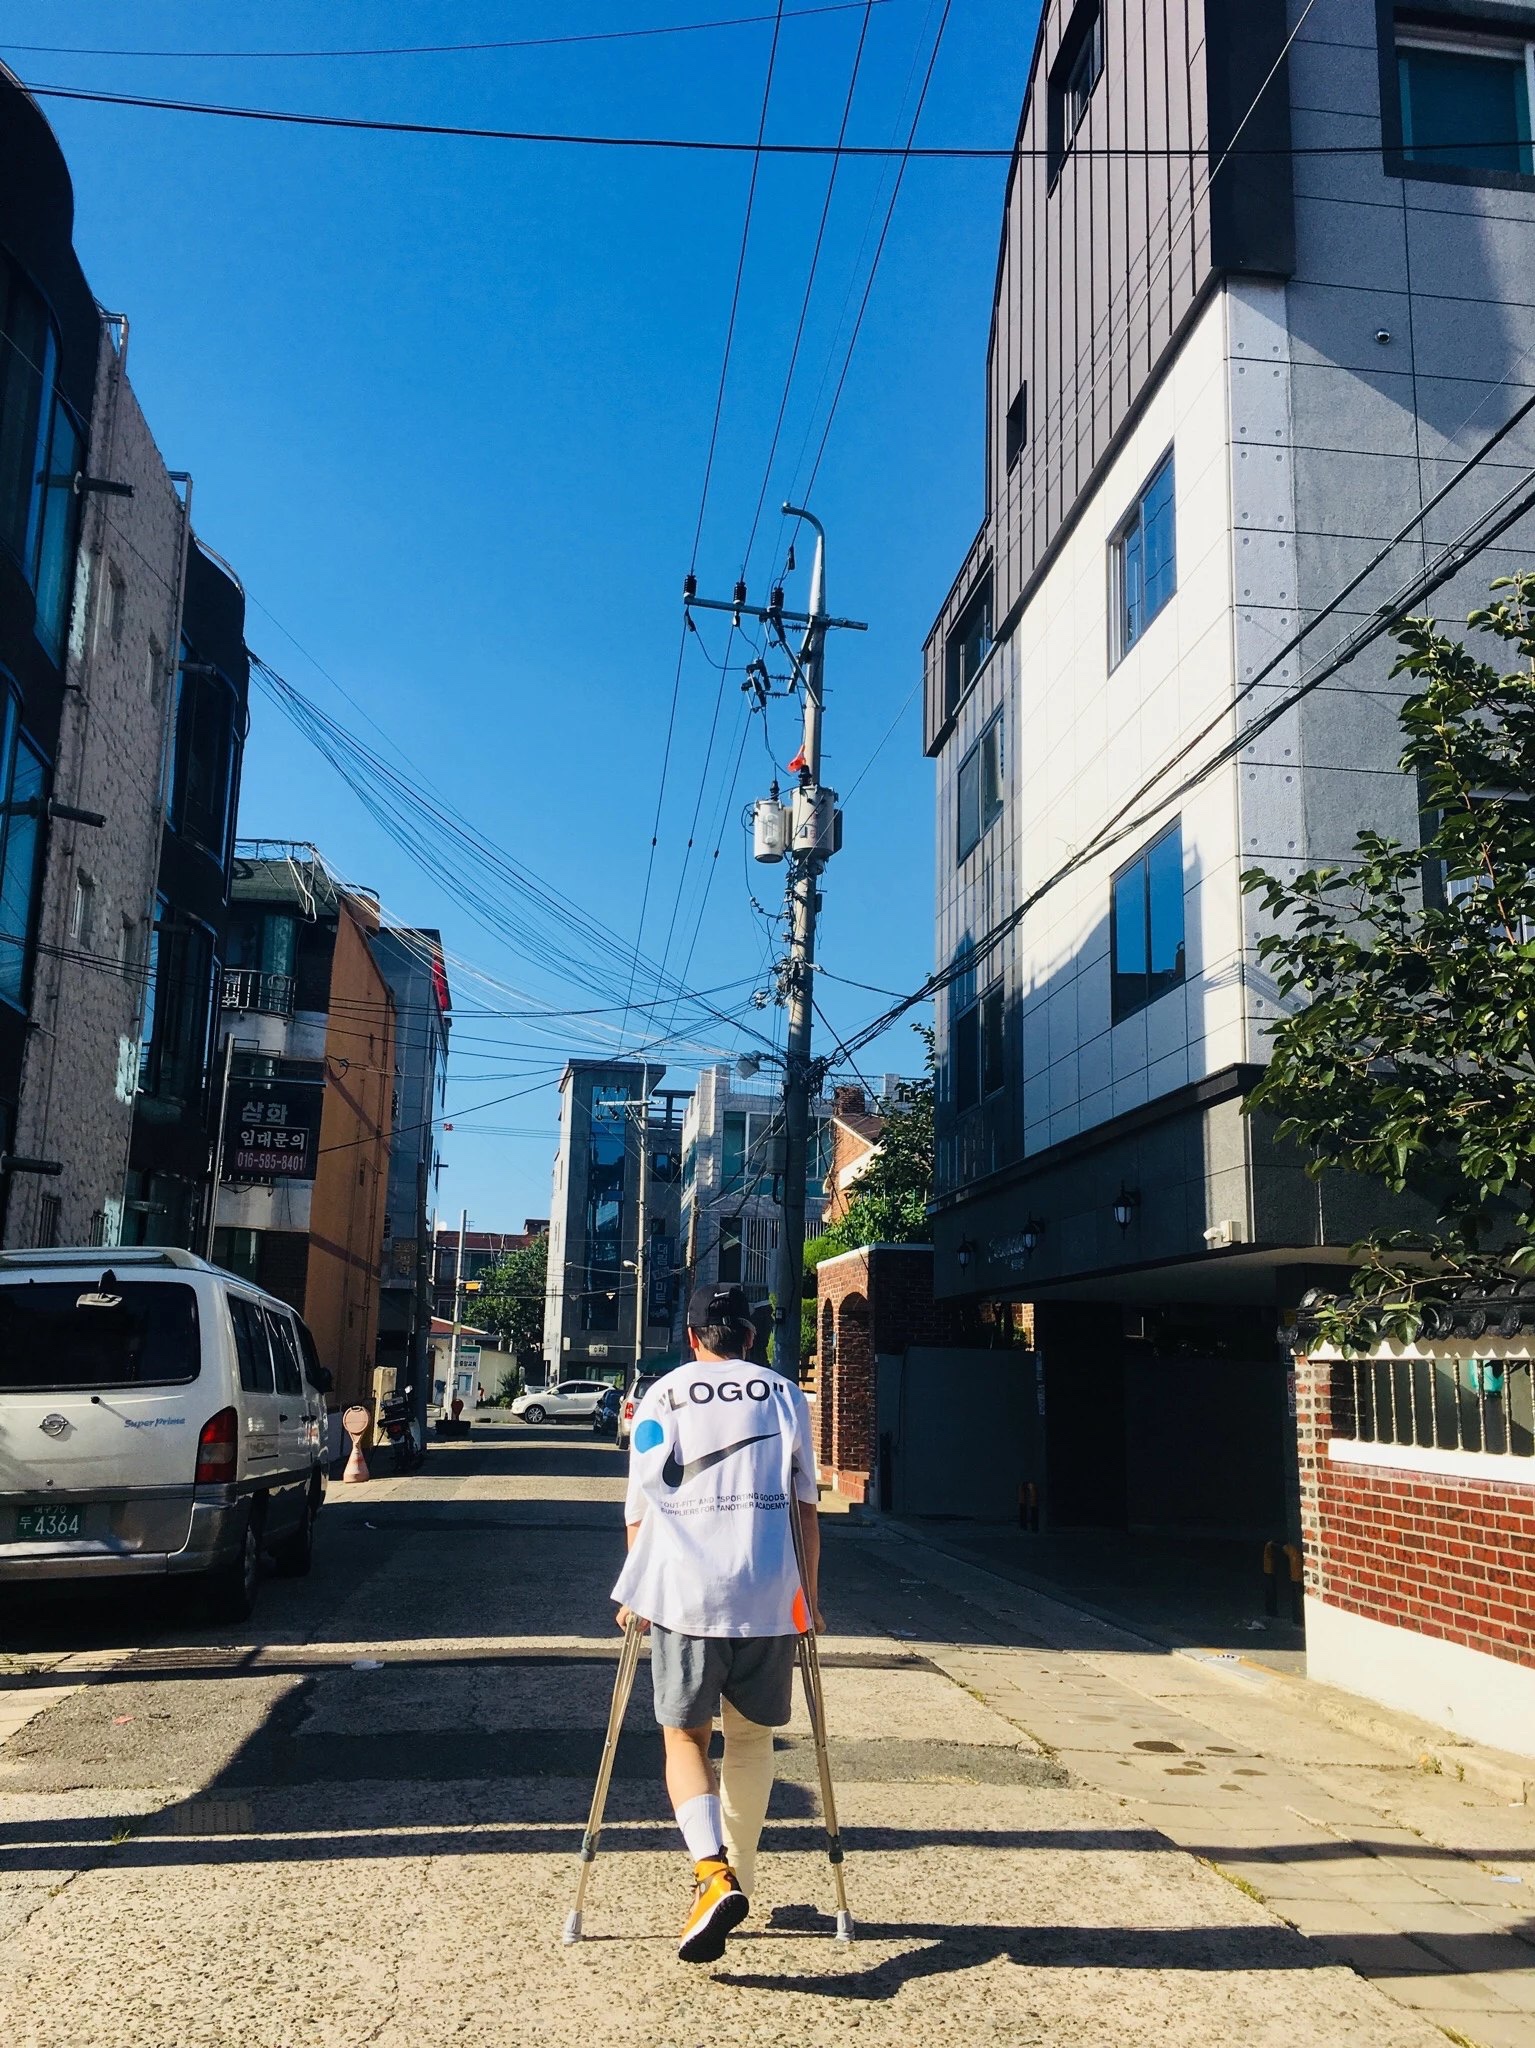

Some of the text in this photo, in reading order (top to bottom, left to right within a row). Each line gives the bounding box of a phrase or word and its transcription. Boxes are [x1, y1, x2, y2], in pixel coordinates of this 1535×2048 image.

[241, 1101, 288, 1125] 삼화
[240, 1129, 305, 1151] 임대문의
[237, 1151, 304, 1171] 016-585-8401
[658, 1378, 784, 1411] "LOGO"
[699, 1497, 715, 1505] AND
[759, 1493, 789, 1502] GOODS"
[700, 1505, 715, 1513] FOR
[717, 1502, 754, 1512] "ANOTHER
[755, 1501, 789, 1511] ACADEMY"
[34, 1514, 79, 1535] 4364
